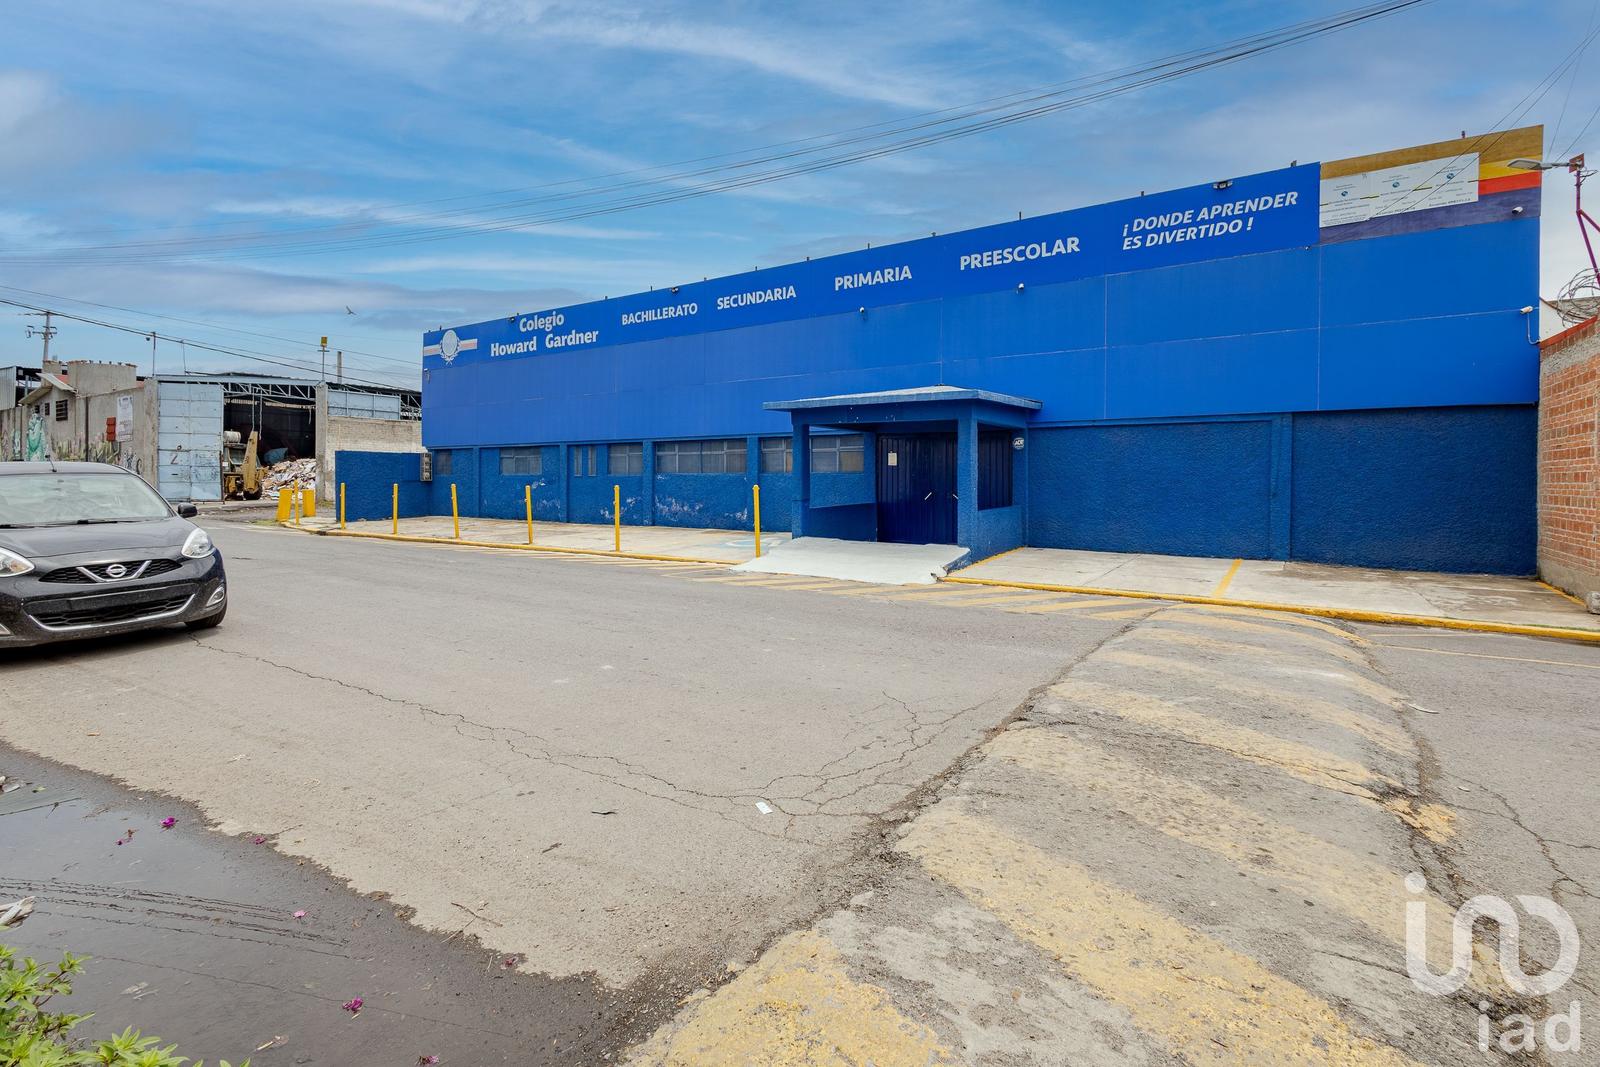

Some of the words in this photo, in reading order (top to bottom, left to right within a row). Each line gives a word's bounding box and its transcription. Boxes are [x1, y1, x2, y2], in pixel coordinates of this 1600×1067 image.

[1196, 191, 1298, 221] APRENDER
[1122, 236, 1142, 250] ES
[1145, 219, 1242, 247] DIVERTIDO
[960, 237, 1080, 270] PREESCOLAR
[834, 265, 912, 291] PRIMARIA
[717, 285, 796, 310] SECUNDARIA
[519, 311, 565, 332] Colegio
[621, 302, 698, 325] BACHILLERATO
[490, 336, 537, 357] Howard
[545, 330, 599, 348] Gardner
